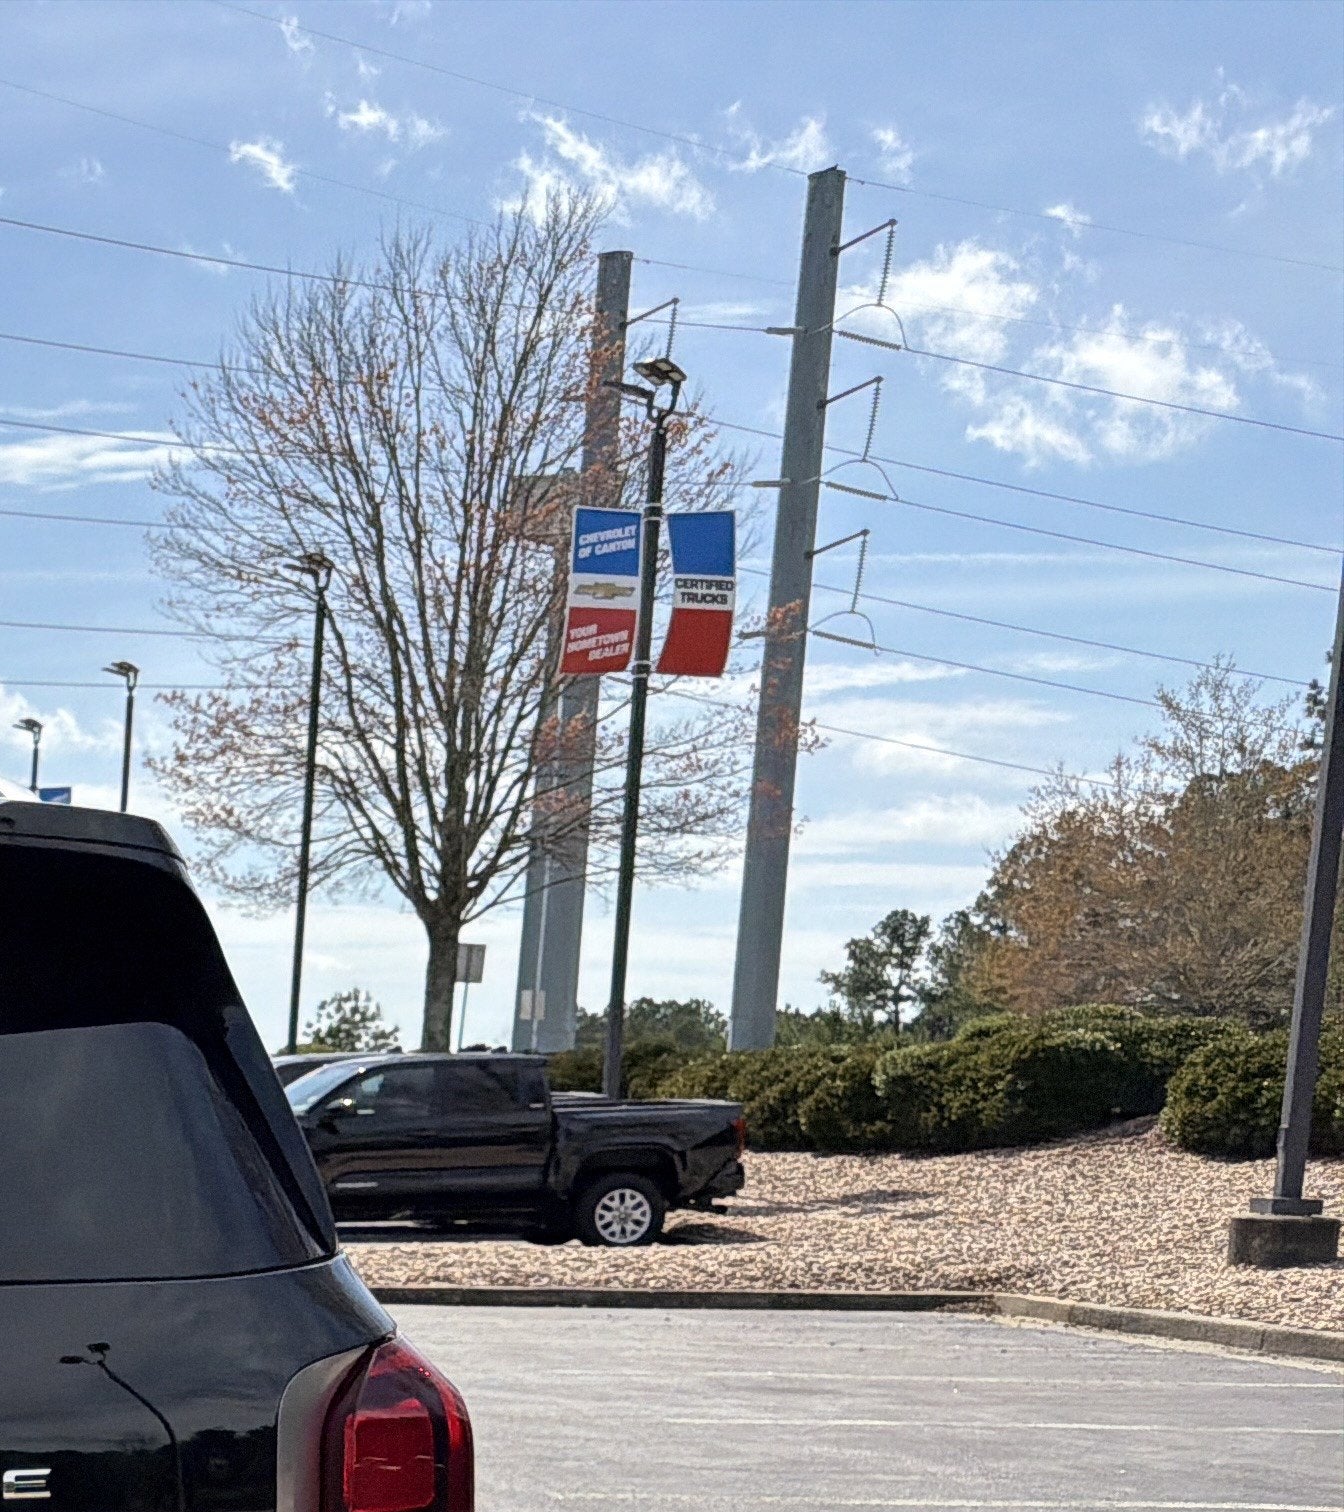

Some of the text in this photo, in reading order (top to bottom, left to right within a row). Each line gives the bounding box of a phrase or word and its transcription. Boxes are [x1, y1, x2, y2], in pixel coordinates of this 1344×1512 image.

[578, 524, 637, 546] CHEVROLET
[594, 538, 636, 556] CANTON
[674, 577, 734, 591] CERTIFIED
[681, 592, 728, 605] TRUCKS
[569, 623, 598, 640] YOUR
[566, 629, 629, 654] HOMETOWN
[588, 642, 630, 661] DEALER
